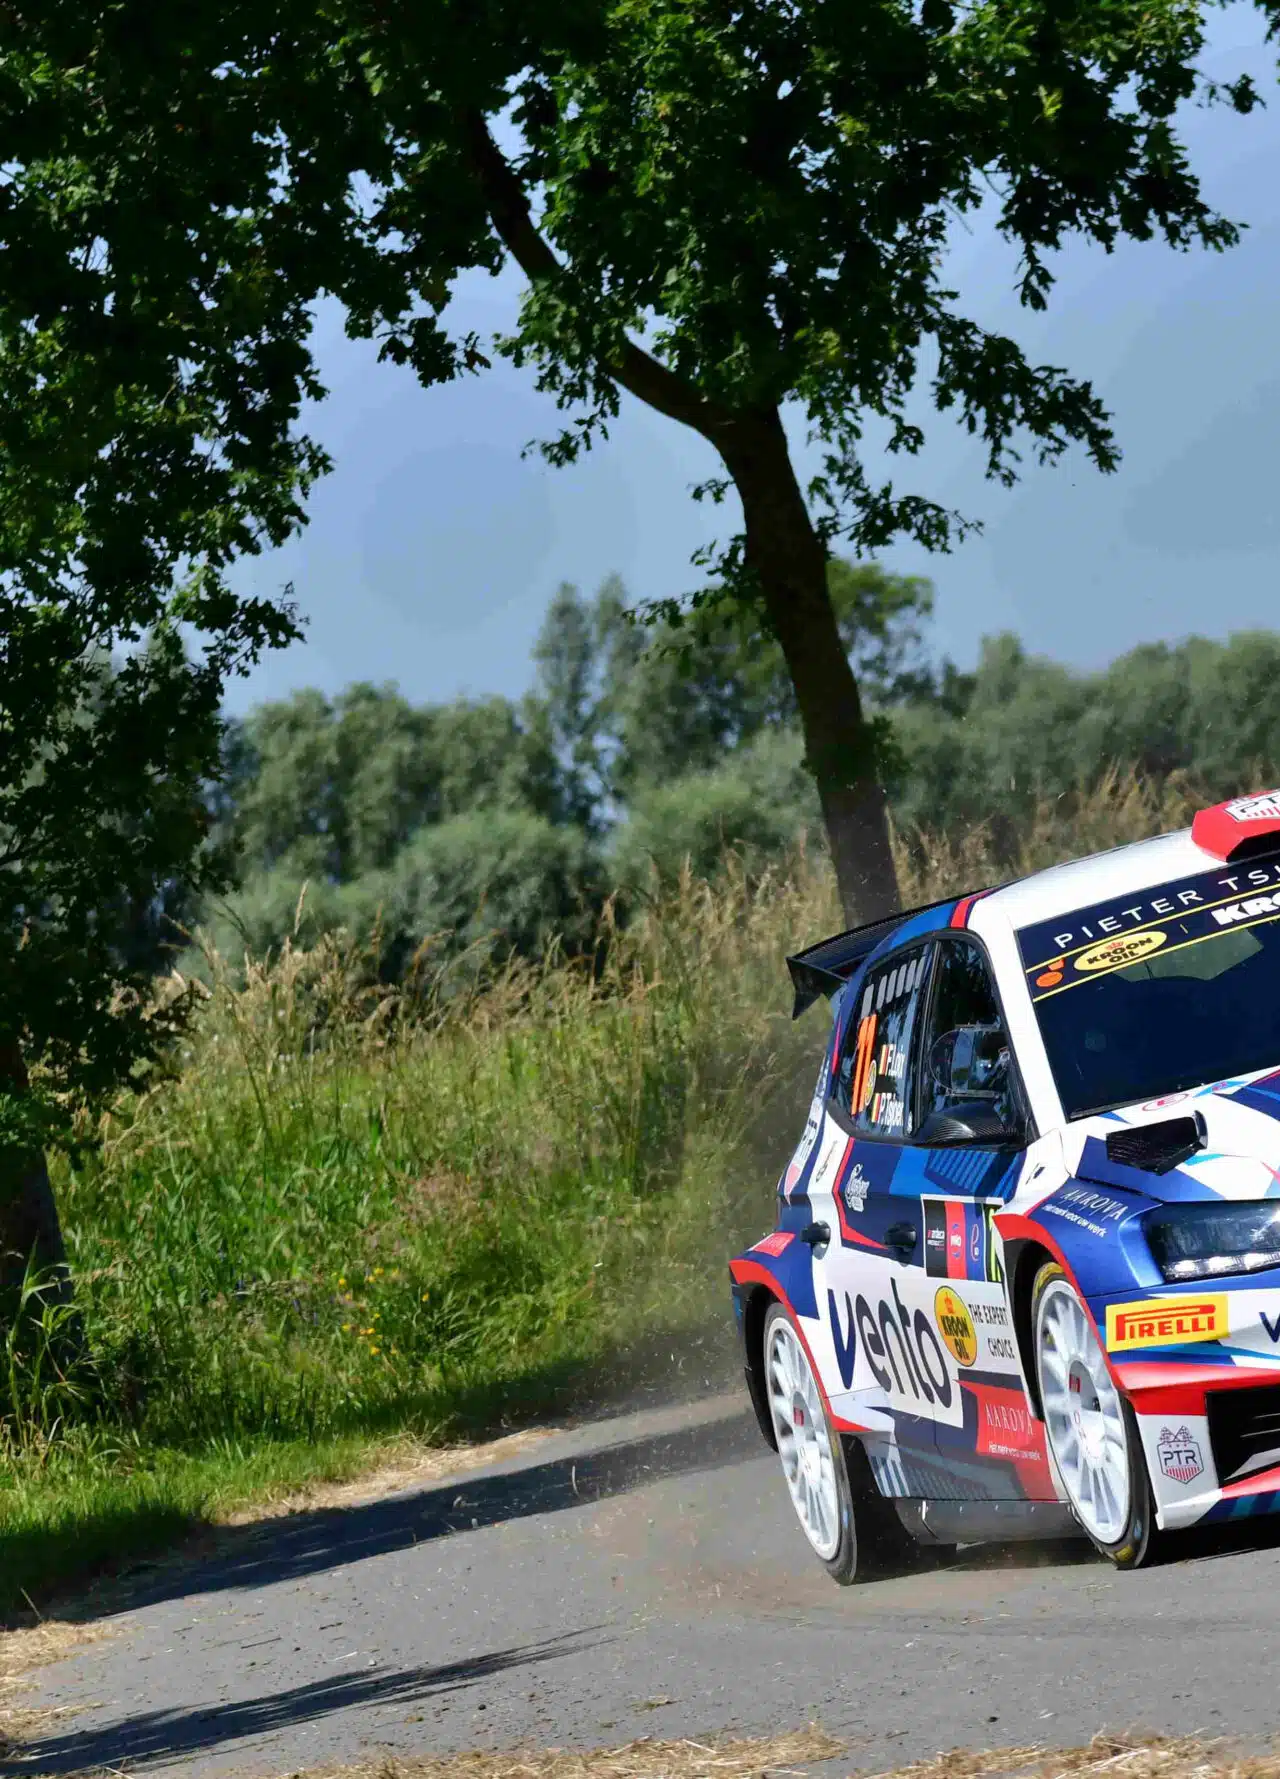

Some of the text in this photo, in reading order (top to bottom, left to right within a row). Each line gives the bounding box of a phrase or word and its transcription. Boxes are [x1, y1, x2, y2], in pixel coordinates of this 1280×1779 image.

[1053, 888, 1204, 950] PIETER
[1086, 937, 1154, 965] KROON
[1108, 950, 1140, 963] OIL
[968, 1303, 1009, 1326] THE EXPERT
[1115, 1303, 1217, 1341] PIRELLI
[940, 1315, 971, 1338] KROON
[827, 1276, 952, 1409] vento
[987, 1337, 1016, 1360] CHOICE
[1162, 1449, 1199, 1467] PTR
